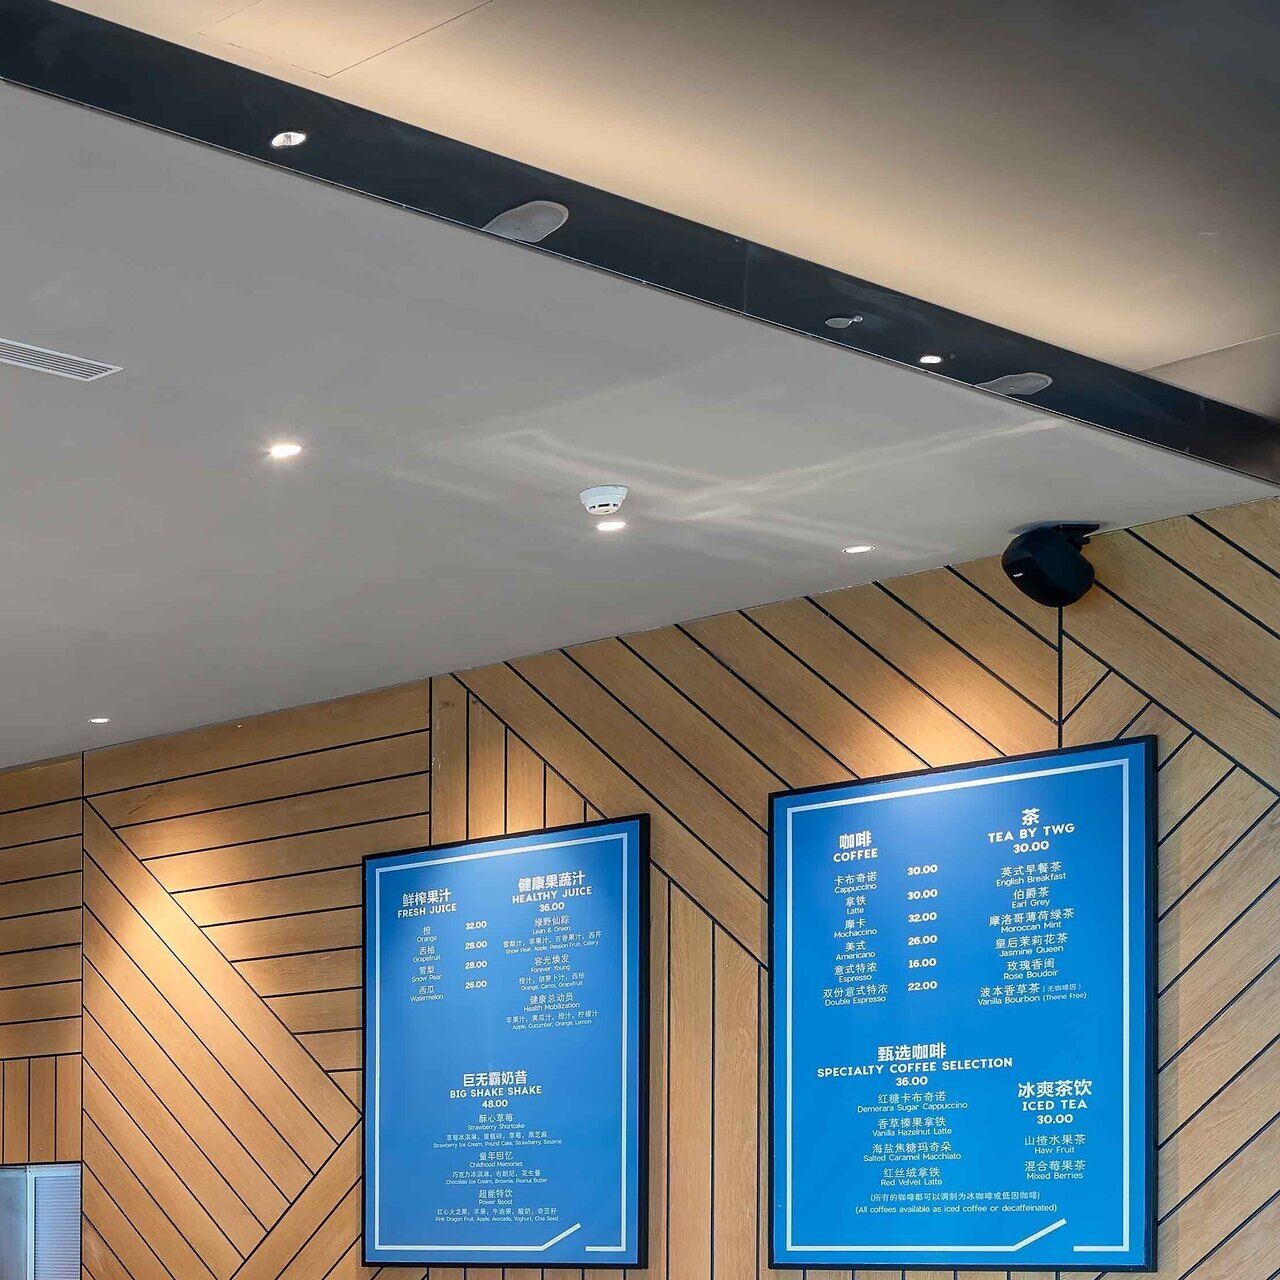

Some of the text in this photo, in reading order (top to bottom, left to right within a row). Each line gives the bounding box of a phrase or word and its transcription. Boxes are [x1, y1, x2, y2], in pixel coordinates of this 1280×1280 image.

[1021, 807, 1040, 826] 茶
[987, 822, 1076, 843] TEA BY TWG
[839, 830, 872, 850] 咖啡
[1013, 840, 1050, 854] 30.00
[833, 848, 878, 863] COFFEE
[907, 864, 938, 876] 30.00
[1001, 861, 1062, 878] 英式早餐茶
[517, 870, 586, 893] 健康果蔬汁
[834, 871, 878, 886] 卡布奇诺
[996, 872, 1067, 888] English Breakfast
[834, 882, 877, 894] Cappuccino
[907, 889, 938, 900] 30.00
[1013, 886, 1050, 901] 伯爵茶
[402, 887, 451, 907] 鲜榨果汁
[512, 886, 593, 904] HEALTHY JUICE
[845, 895, 867, 908] 拿铁
[397, 903, 457, 918] FRESH JUICE
[1011, 899, 1051, 909] Earl Grey
[846, 907, 865, 915] Latte
[908, 912, 937, 923] 32.00
[465, 920, 487, 930] 32.00
[845, 918, 866, 931] 摩卡
[416, 935, 437, 943] Orange
[834, 928, 878, 939] Mochaccino
[465, 940, 488, 950] 28.00
[845, 940, 867, 952] 美式
[907, 935, 938, 946] 26.00
[995, 932, 1069, 950] 皇后茉莉花茶
[835, 951, 876, 961] Americano
[999, 945, 1064, 958] Jasmine Queen
[465, 960, 488, 970] 28.00
[834, 962, 878, 976] 意式特浓
[908, 958, 937, 968] 16.00
[465, 980, 487, 990] 26.00
[838, 974, 872, 984] Espresso
[822, 984, 888, 999] 双份意式特浓
[907, 981, 938, 991] 22.00
[409, 993, 444, 1002] Watermelon
[824, 995, 887, 1006] Double Espresso
[877, 1042, 947, 1062] 甄选咖啡
[817, 1057, 1013, 1078] SPECIALTY COFFEE SELECTION
[463, 1070, 528, 1088] 巨无霸奶昔
[895, 1076, 928, 1087] 36.00
[450, 1085, 542, 1099] BIG SHAKE SHAKE
[1017, 1079, 1093, 1098] 冰爽茶饮
[482, 1099, 509, 1109] 48.00
[857, 1101, 968, 1114] Demerara Sugar Cappuccino
[1022, 1098, 1088, 1112] ICED TEA
[1036, 1113, 1074, 1125] 30.00
[1026, 1171, 1084, 1180] Mixed Berries
